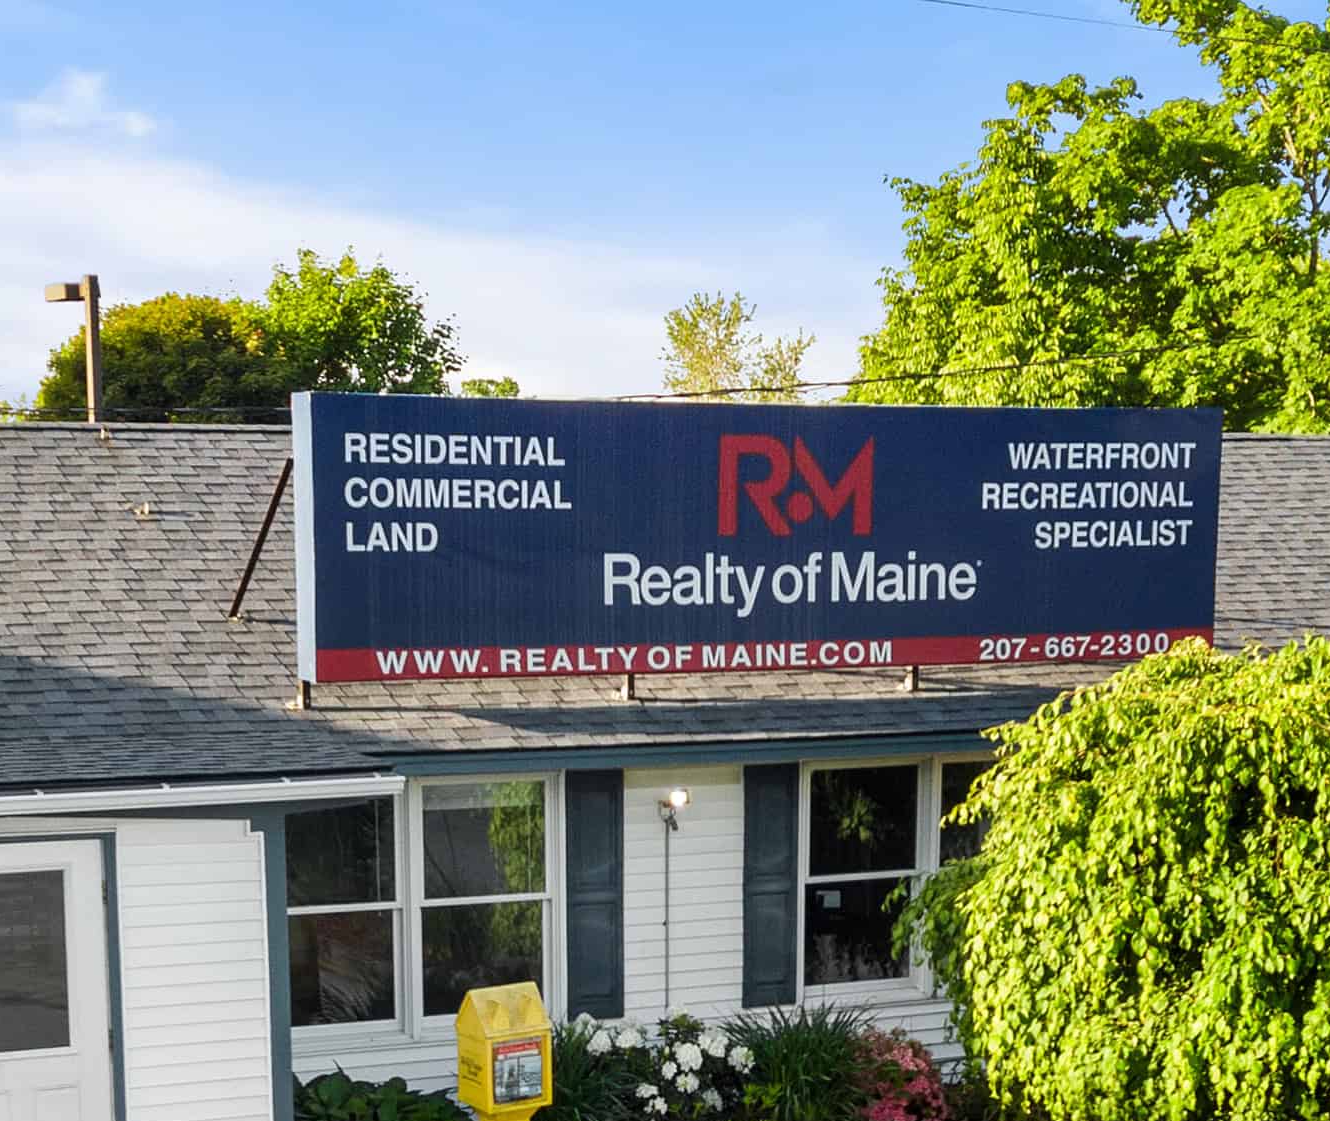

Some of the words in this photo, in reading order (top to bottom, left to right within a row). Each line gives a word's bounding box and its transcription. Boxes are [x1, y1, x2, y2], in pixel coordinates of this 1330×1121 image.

[344, 433, 566, 467] RESIDENTIAL
[1008, 442, 1197, 470] WATERFRONT
[344, 477, 573, 510] COMMERCIAL
[981, 481, 1194, 510] RECREATIONAL
[346, 522, 439, 552] LAND
[1034, 519, 1193, 549] SPECIALIST
[603, 552, 766, 618] Realty
[771, 552, 822, 604] of
[830, 550, 978, 603] Maine
[500, 647, 638, 673] REALTY
[647, 645, 694, 670] OF
[702, 641, 892, 668] MAINE.COM
